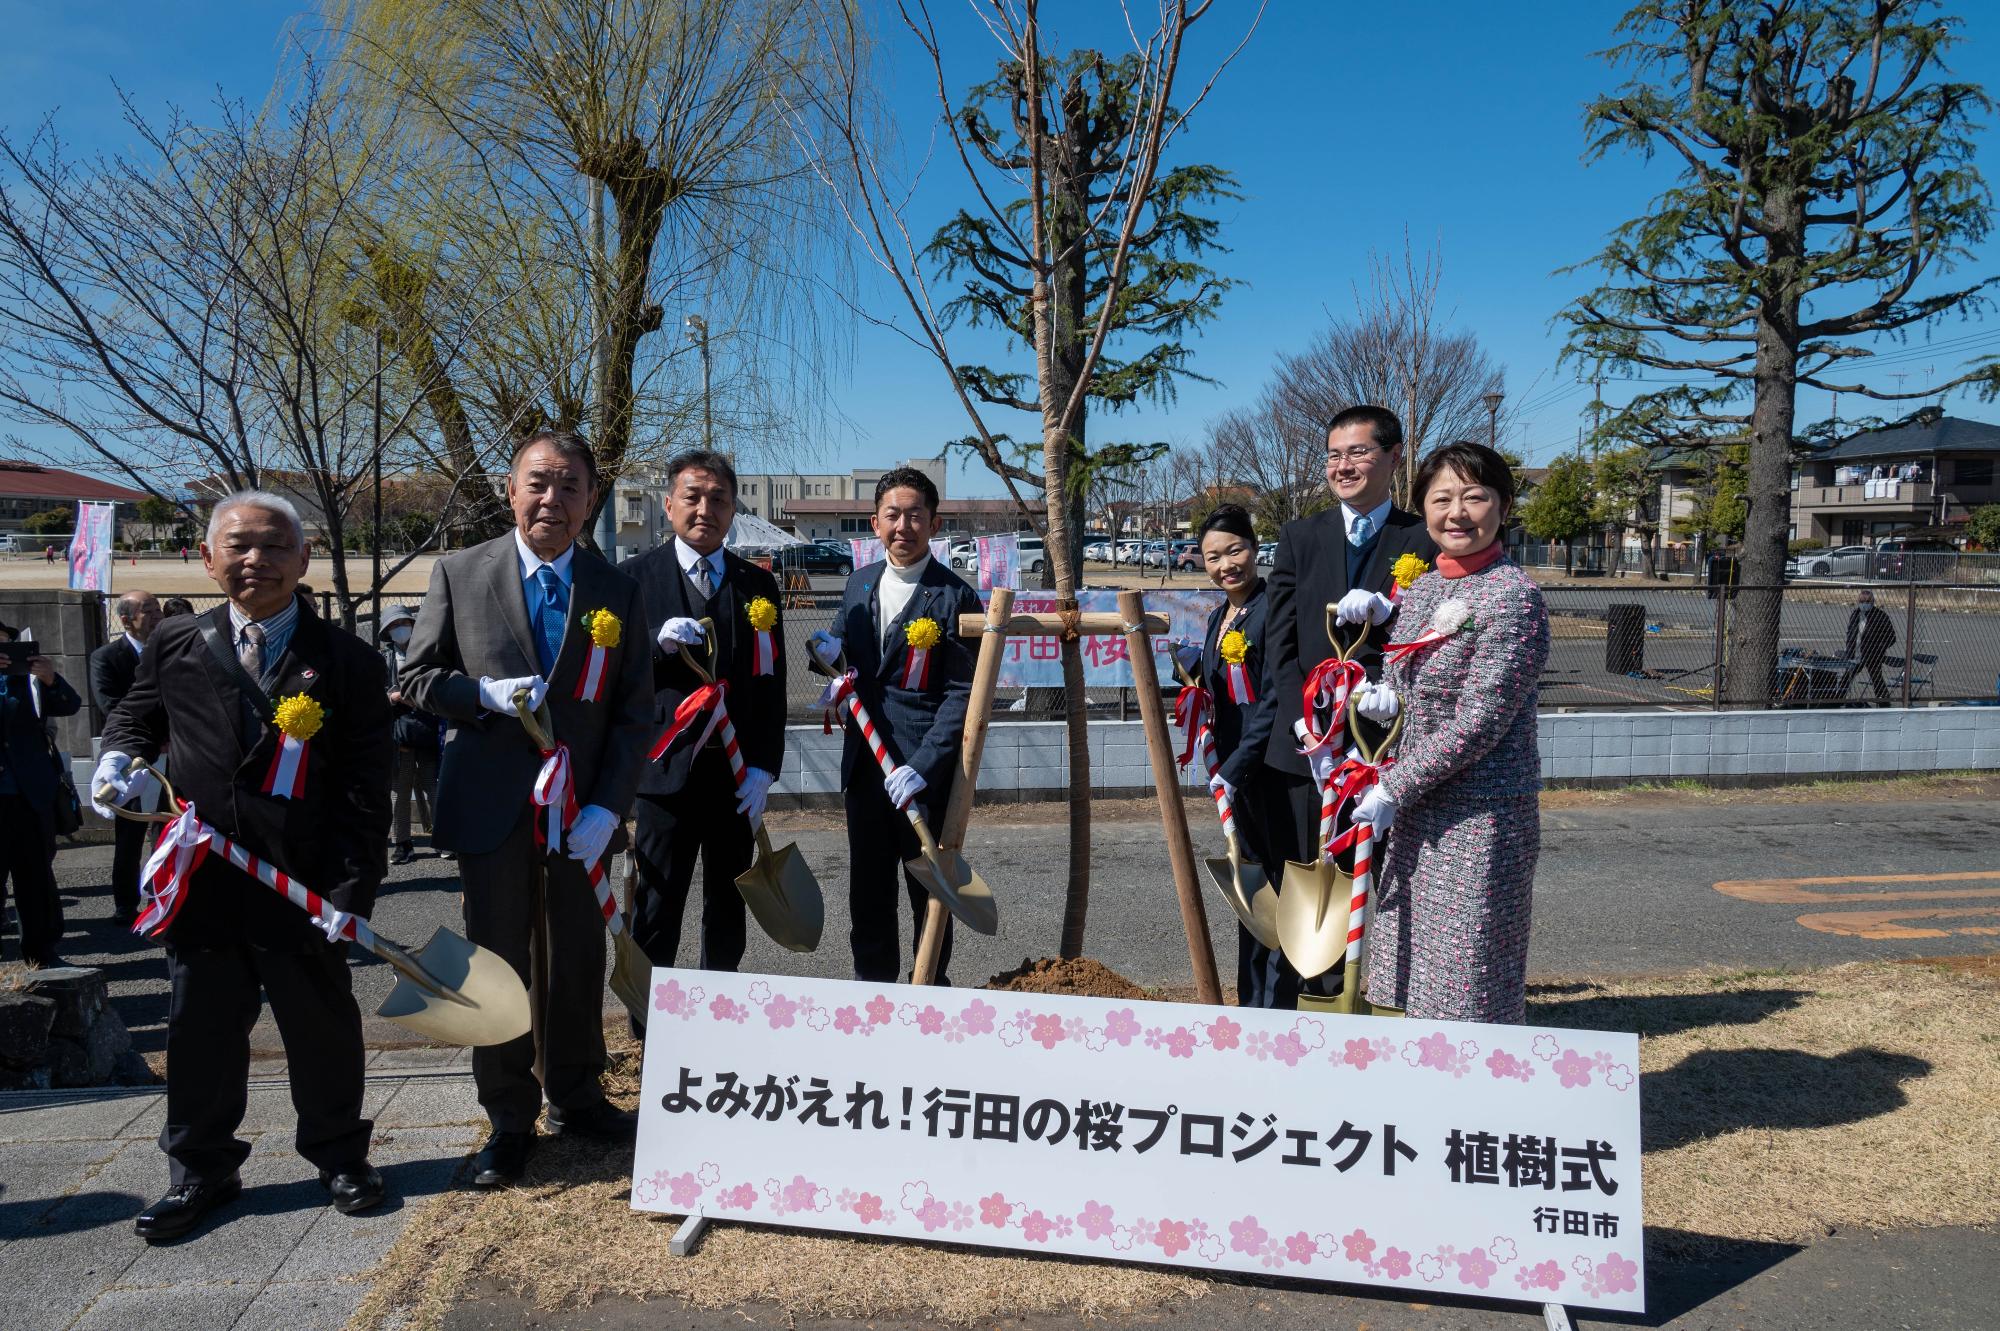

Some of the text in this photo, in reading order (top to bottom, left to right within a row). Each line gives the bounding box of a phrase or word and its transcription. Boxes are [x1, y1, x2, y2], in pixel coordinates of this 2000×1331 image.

[1444, 1127, 1620, 1197] 植樹式
[1532, 1205, 1621, 1240] 行田市
